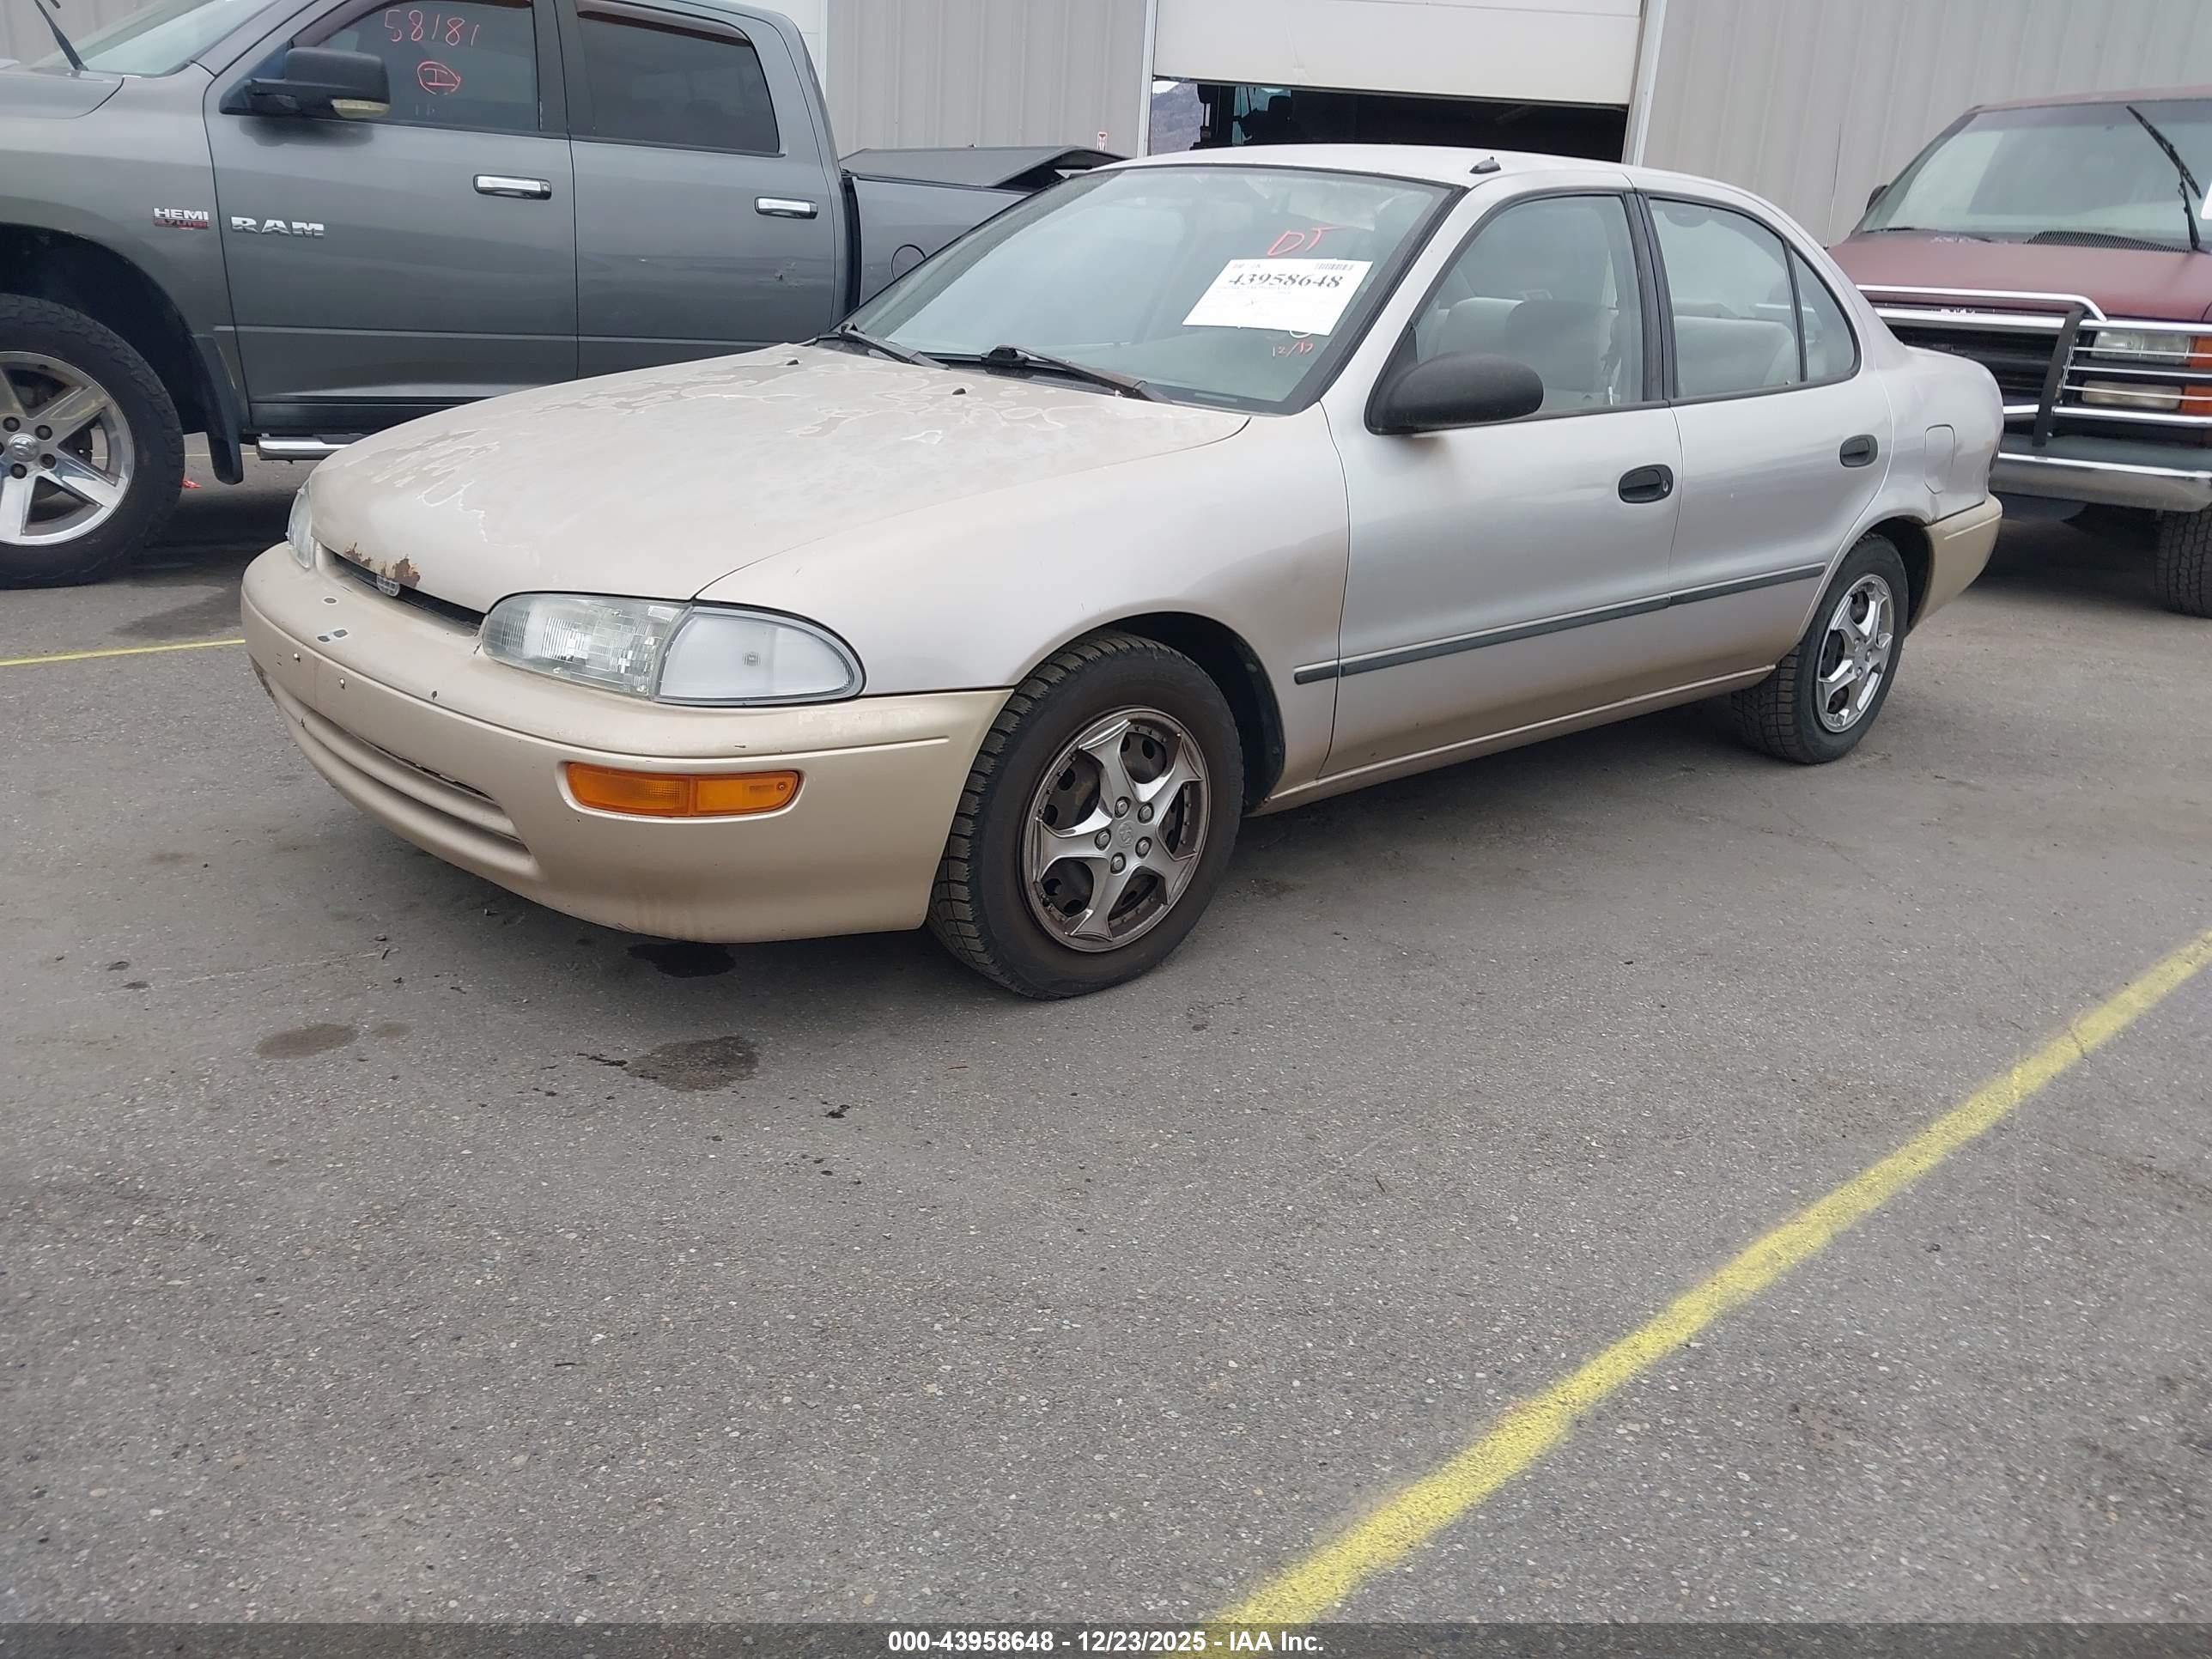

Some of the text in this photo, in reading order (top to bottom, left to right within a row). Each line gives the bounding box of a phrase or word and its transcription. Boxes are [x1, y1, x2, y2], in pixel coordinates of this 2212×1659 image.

[384, 9, 480, 46] 58181
[153, 208, 210, 221] HEMI
[230, 216, 325, 237] RAM
[1267, 226, 1346, 257] DT
[1229, 272, 1344, 289] 43958648
